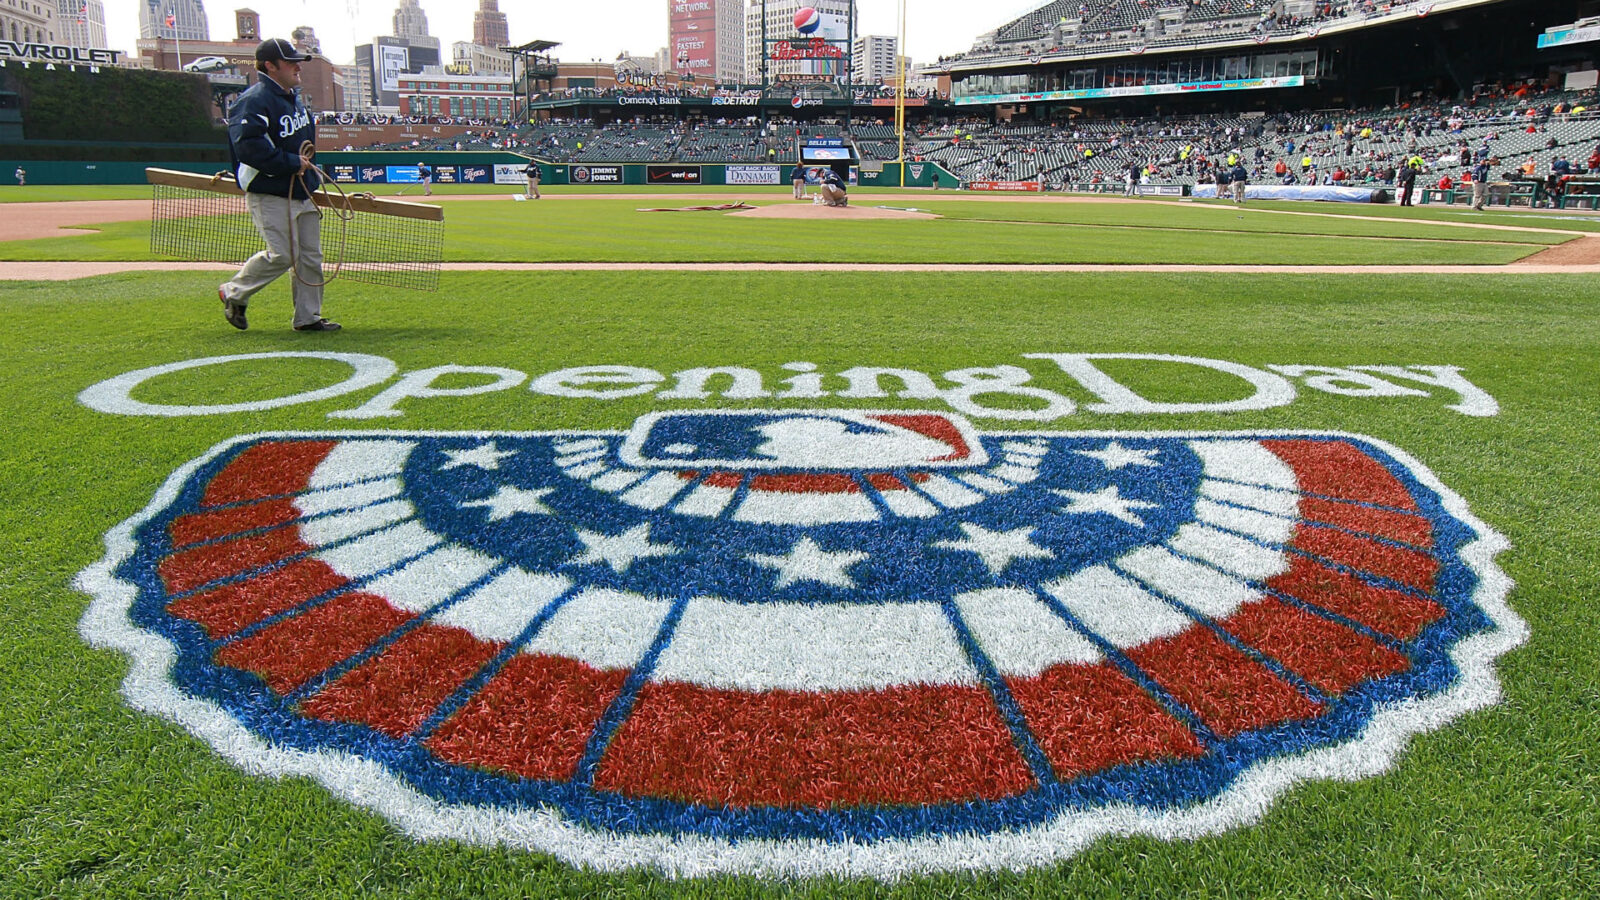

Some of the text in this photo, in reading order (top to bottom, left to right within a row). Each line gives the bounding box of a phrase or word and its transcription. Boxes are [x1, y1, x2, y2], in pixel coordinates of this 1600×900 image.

[677, 42, 705, 50] FASTEST
[448, 64, 470, 75] WJR
[724, 96, 760, 105] DETROIT
[731, 170, 777, 180] DYNAMIC
[972, 180, 990, 190] xfinity
[79, 352, 1499, 421] Opening Day
